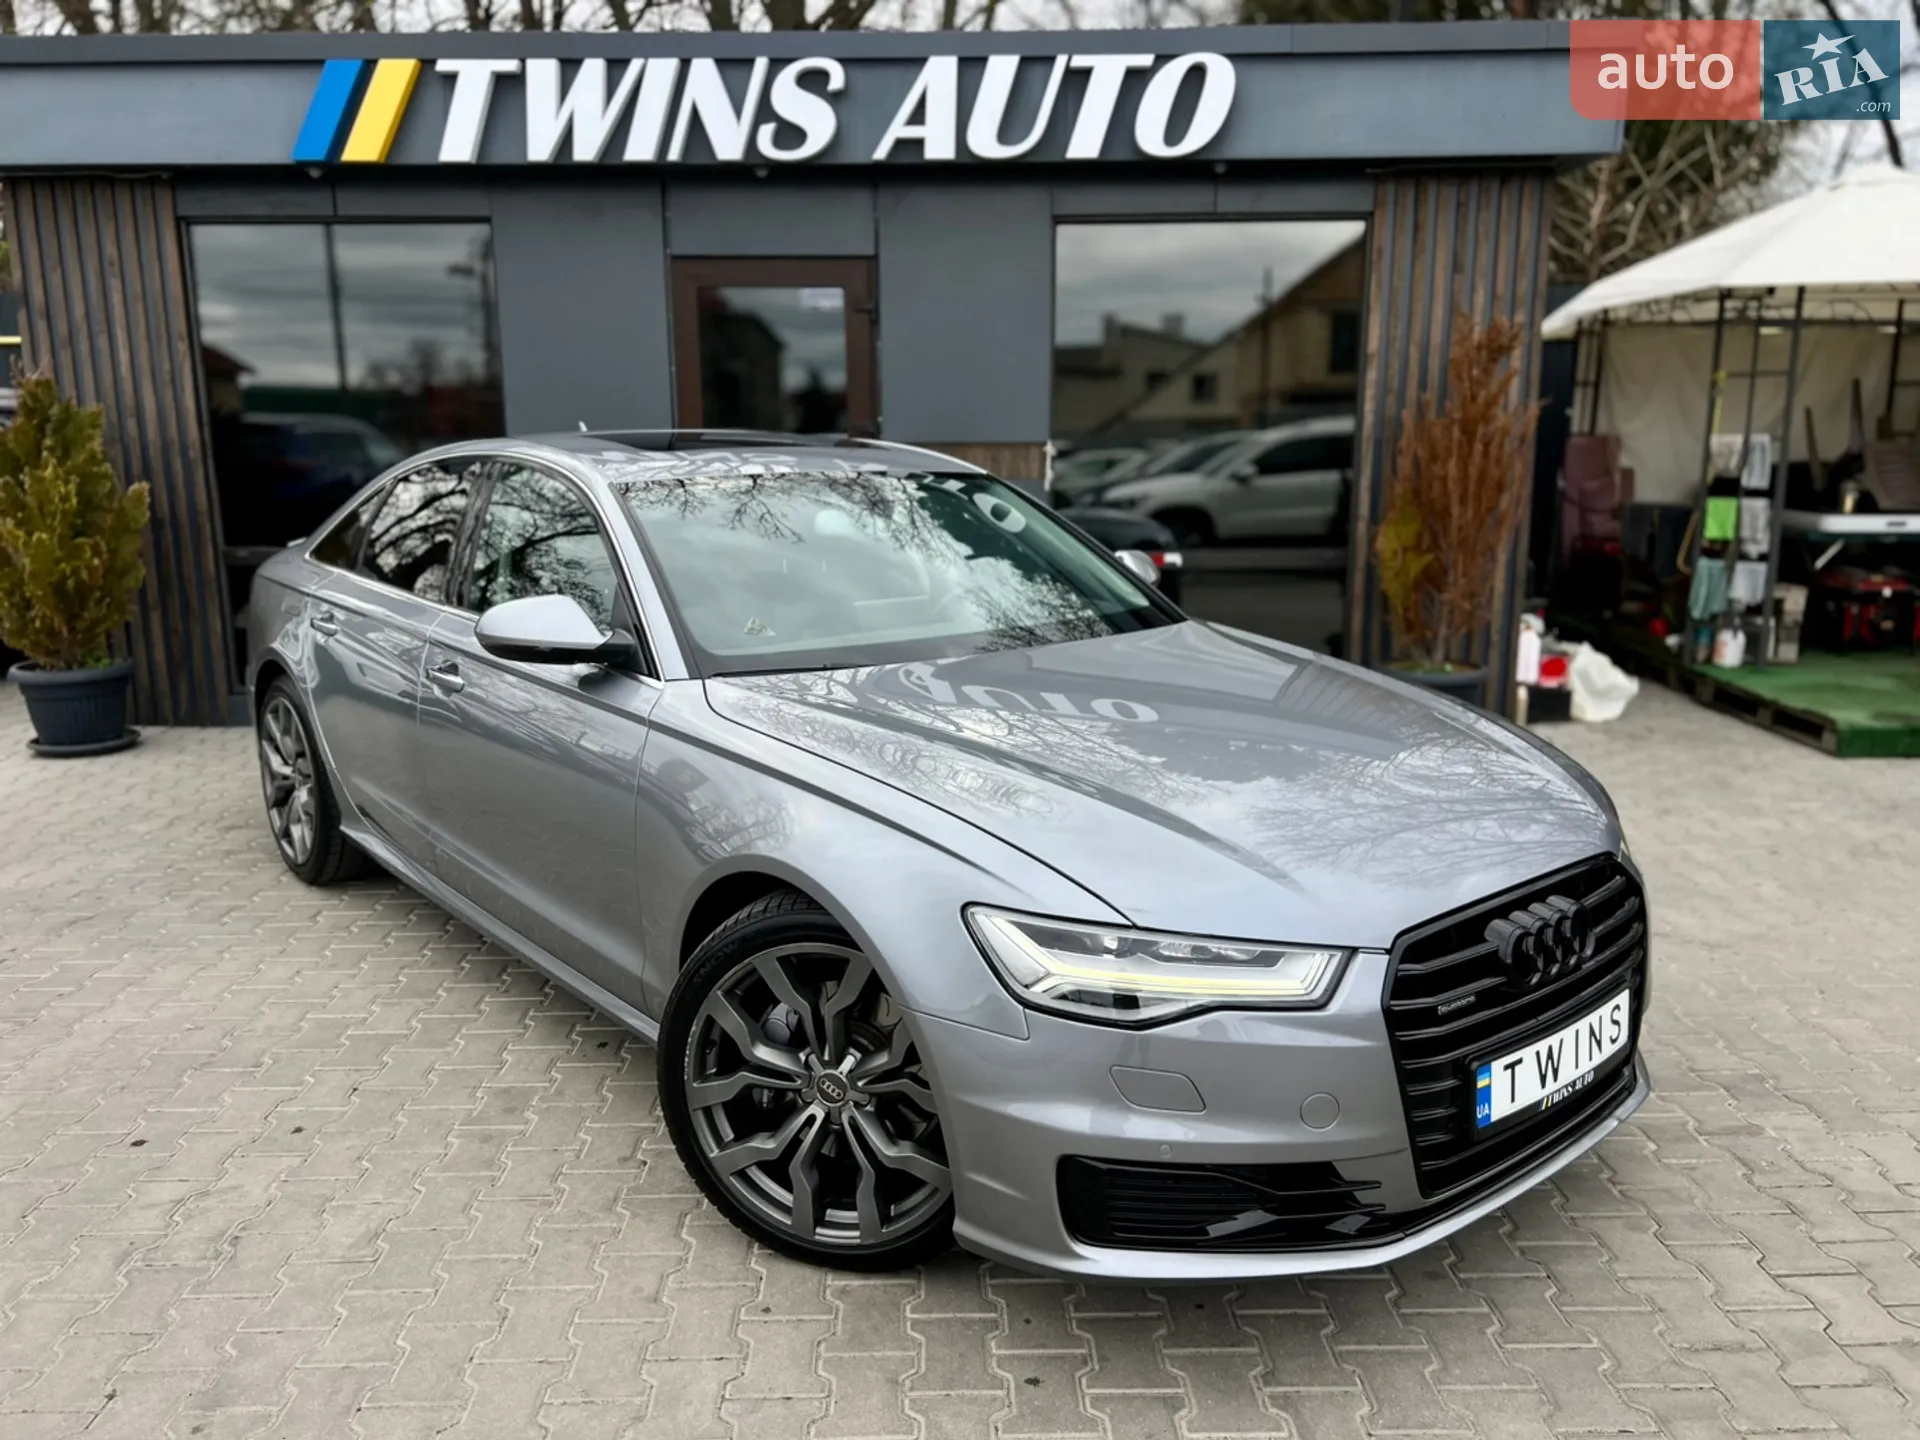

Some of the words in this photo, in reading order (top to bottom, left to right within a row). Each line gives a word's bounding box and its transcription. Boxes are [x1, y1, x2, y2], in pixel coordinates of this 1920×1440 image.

[434, 55, 846, 164] TWINS
[872, 51, 1237, 160] AUTO
[1503, 1003, 1622, 1104] TWINS
[1476, 1102, 1490, 1119] UA
